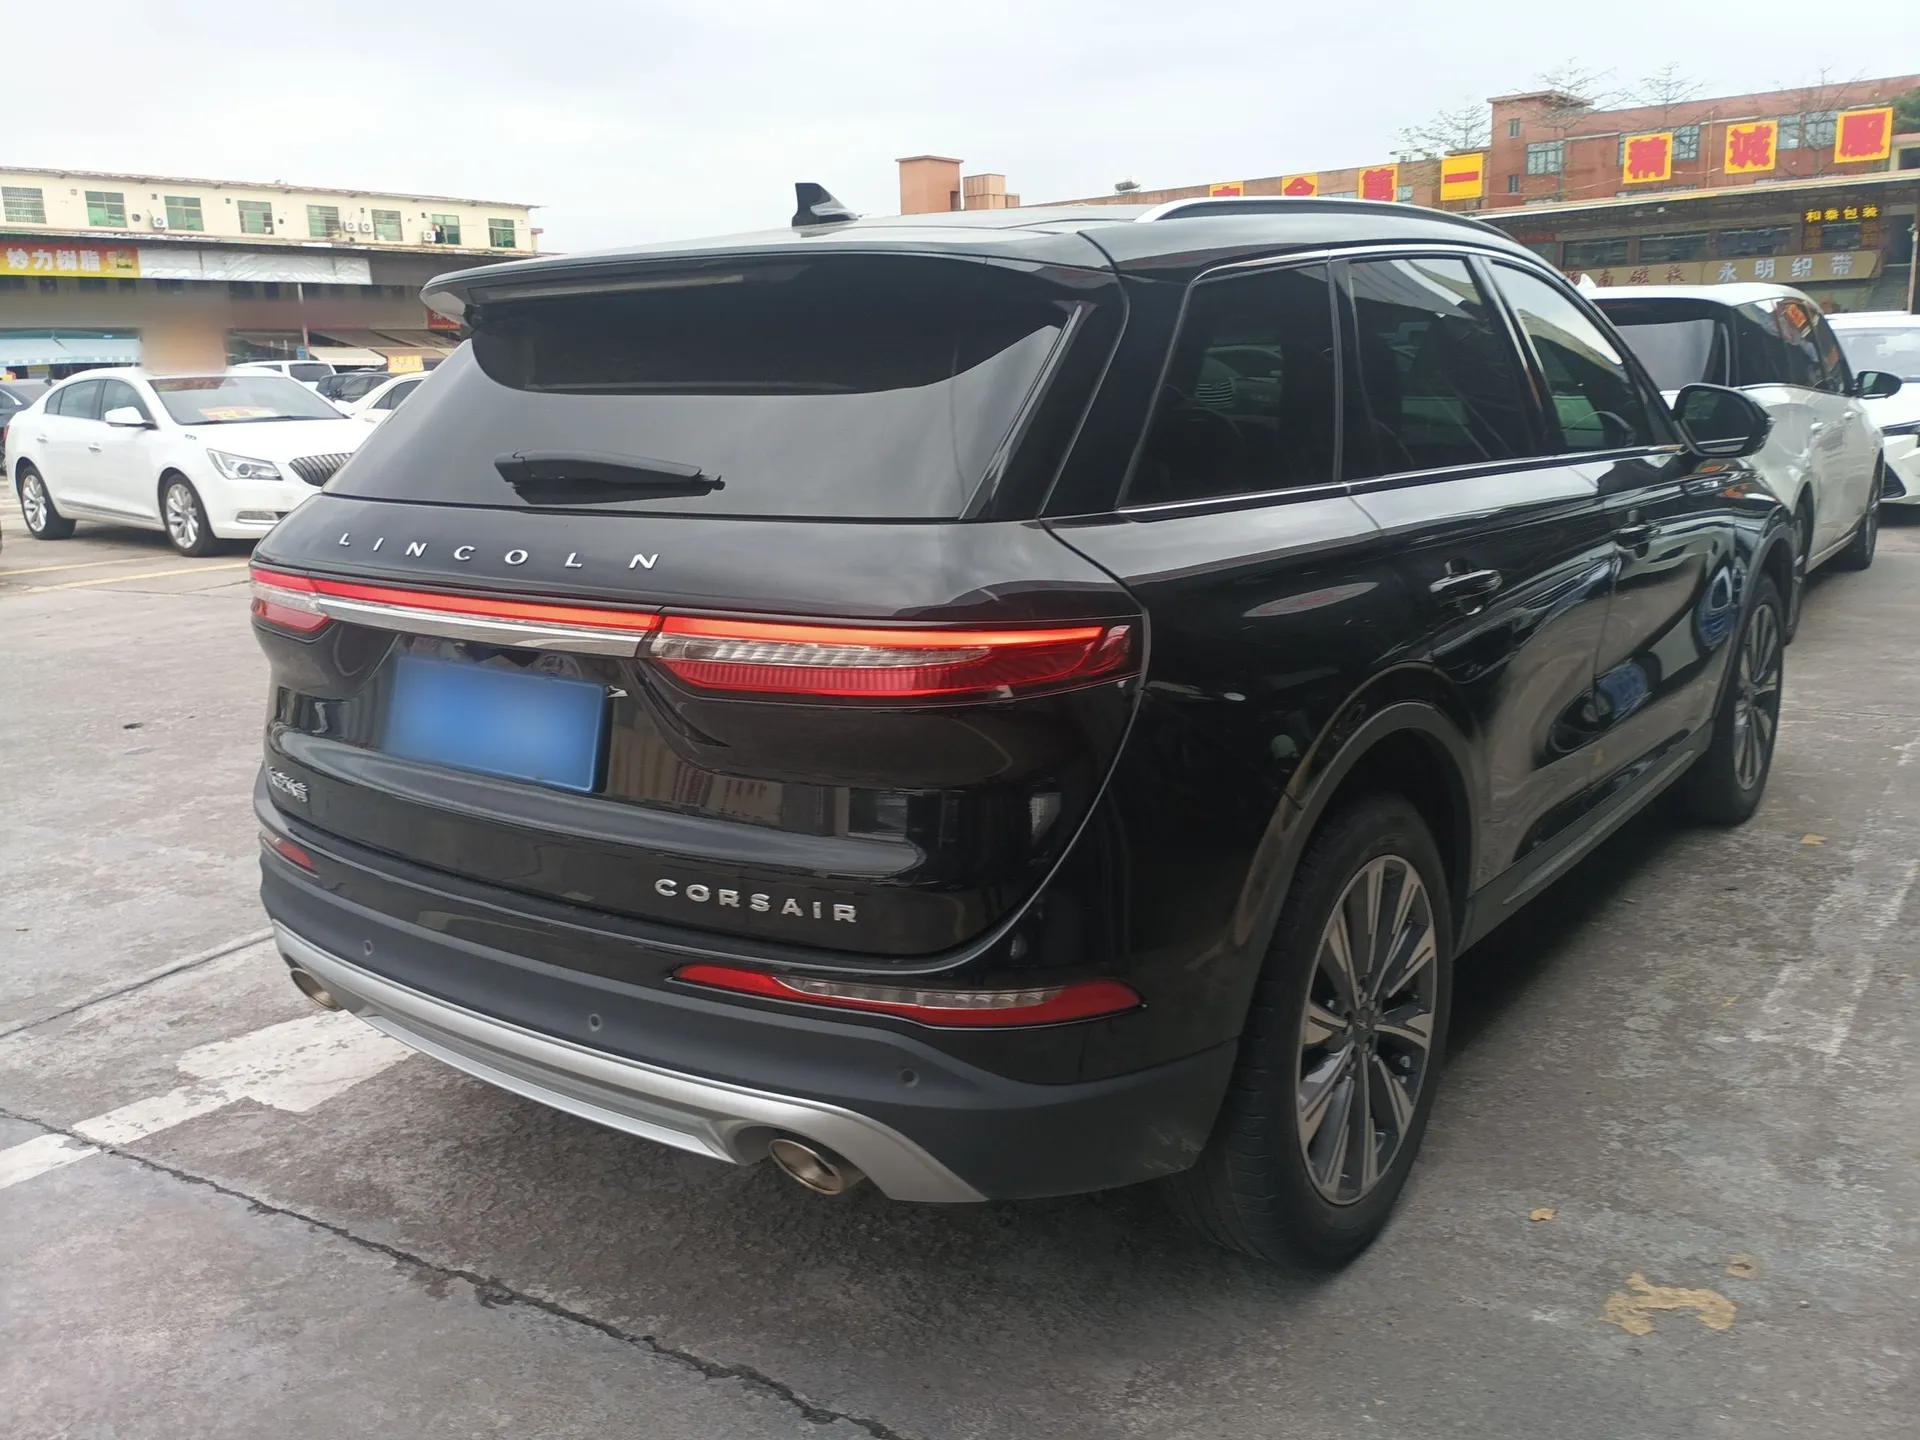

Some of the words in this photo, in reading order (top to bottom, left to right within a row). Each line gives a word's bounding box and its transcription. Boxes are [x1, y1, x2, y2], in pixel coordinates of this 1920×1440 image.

[1718, 255, 1853, 283] 永明织带
[339, 532, 658, 569] LINCOLN
[654, 878, 857, 923] CORSAIR
